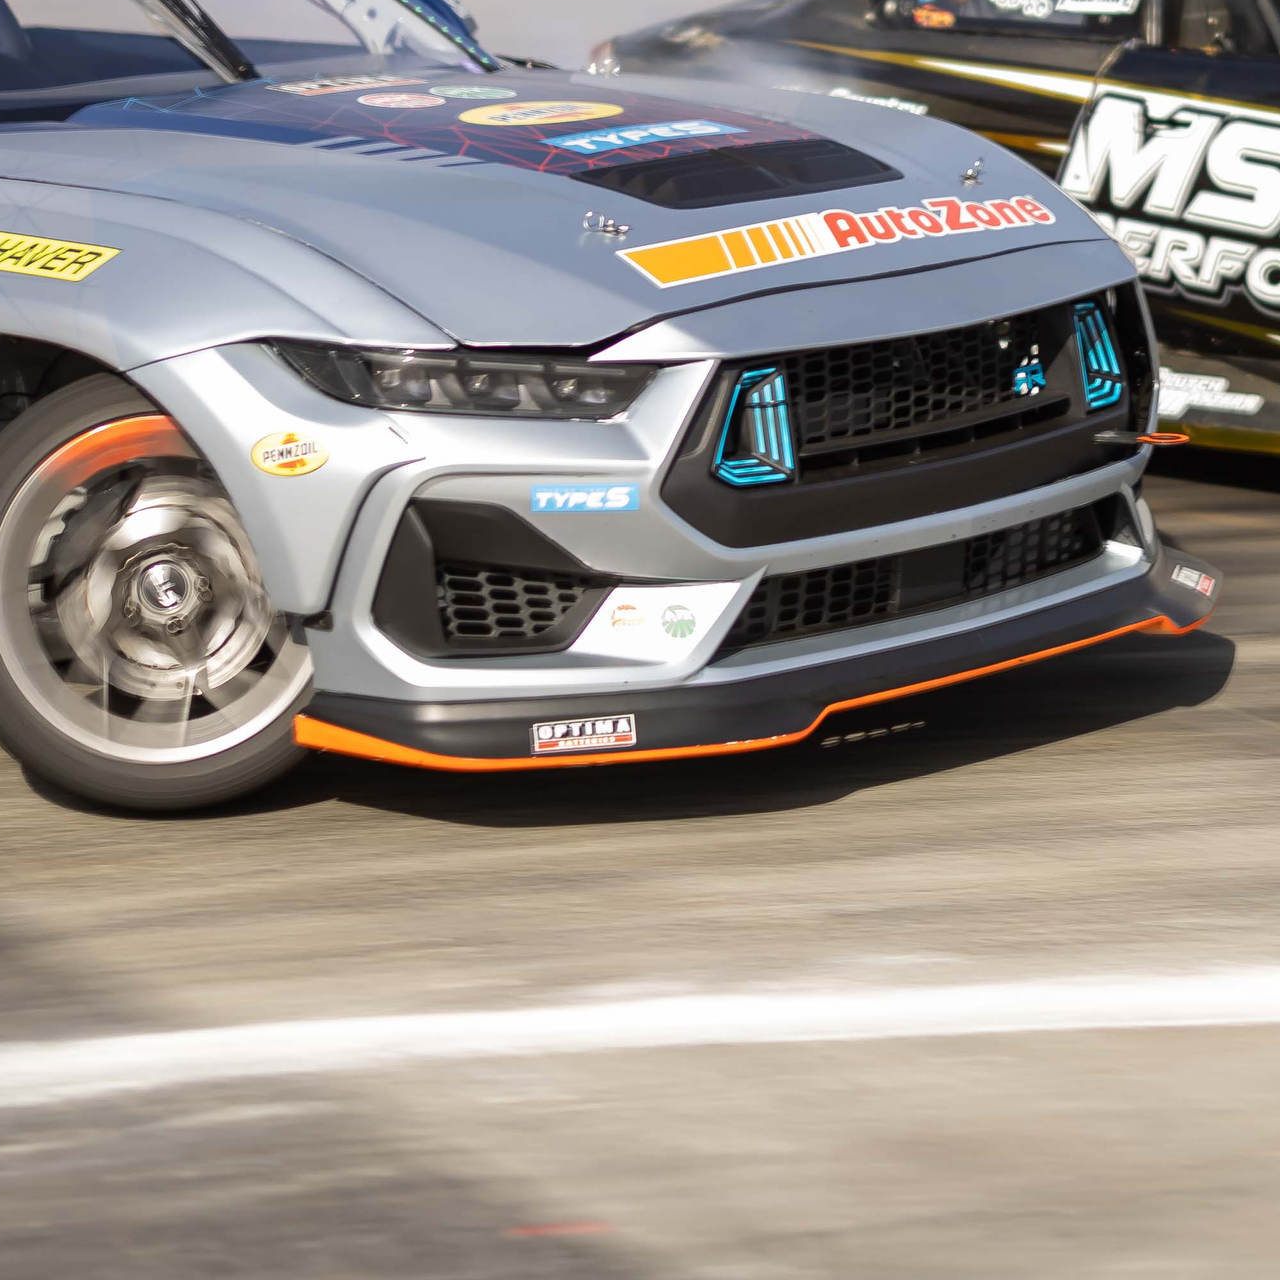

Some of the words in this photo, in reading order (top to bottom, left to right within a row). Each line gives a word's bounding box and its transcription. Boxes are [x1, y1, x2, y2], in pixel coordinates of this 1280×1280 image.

[824, 197, 1054, 249] AutoZone
[261, 441, 319, 464] PENNZOIL
[538, 718, 632, 740] OPTIMA
